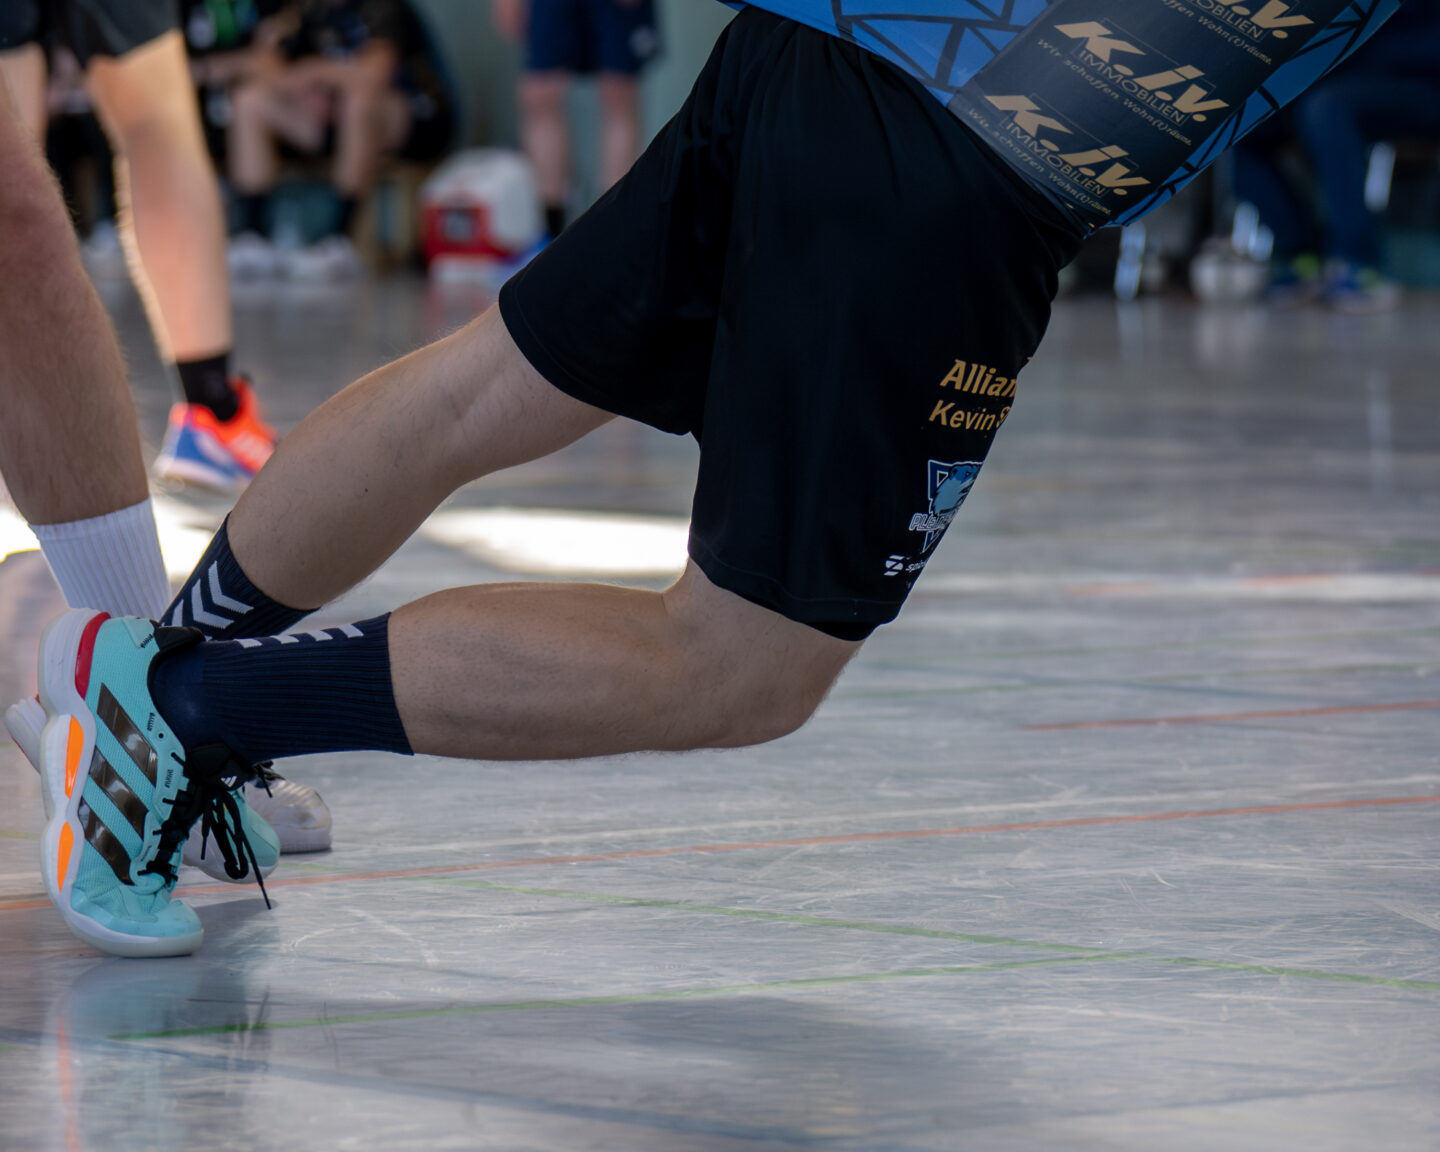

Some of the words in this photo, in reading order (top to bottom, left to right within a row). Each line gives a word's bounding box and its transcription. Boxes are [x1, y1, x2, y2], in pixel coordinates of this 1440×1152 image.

[1079, 49, 1186, 123] IMMOBILIEN
[1005, 119, 1106, 196] IMMOBILIEN
[929, 400, 996, 430] Kevin
